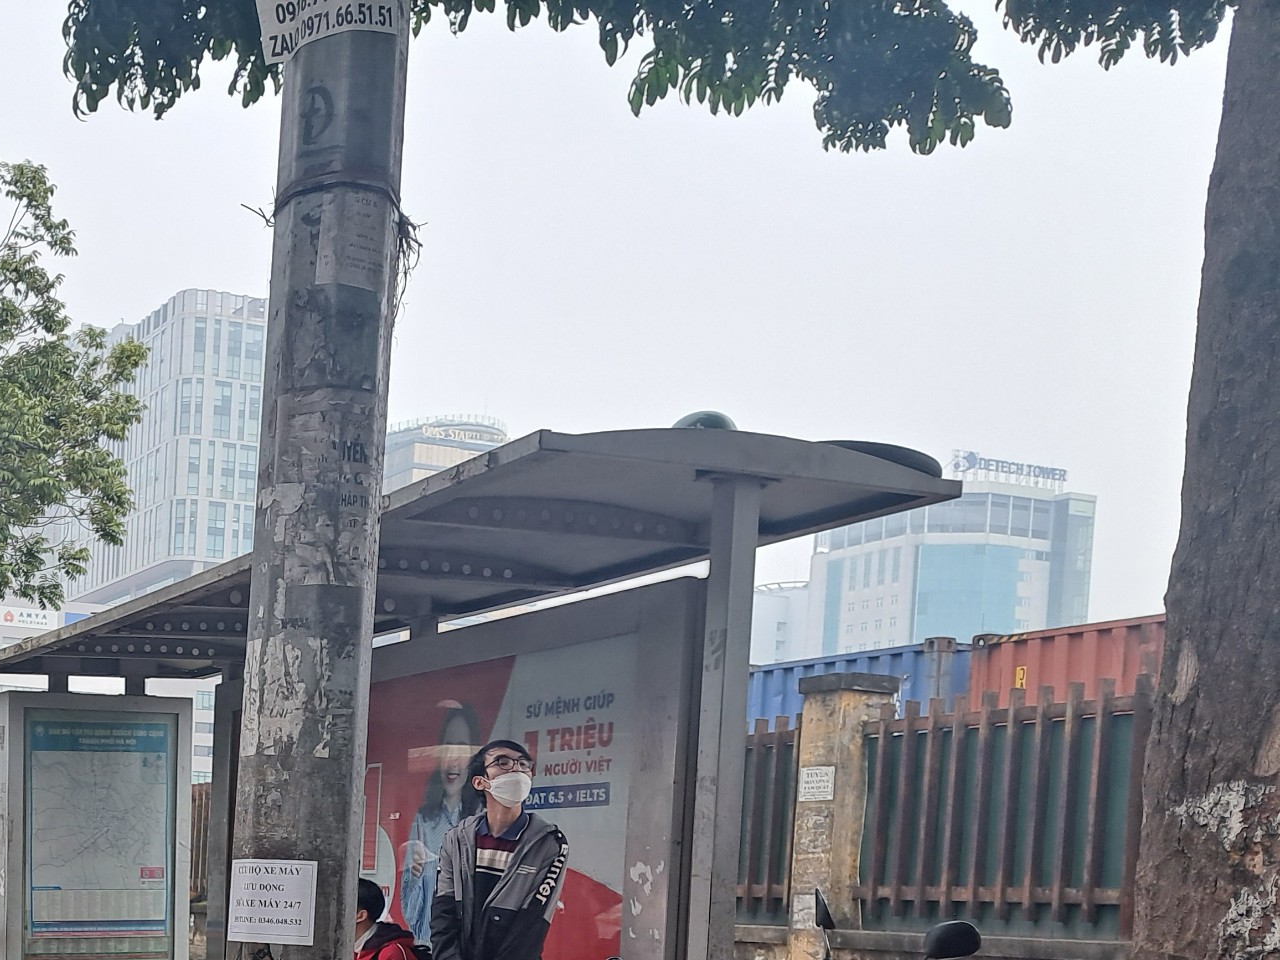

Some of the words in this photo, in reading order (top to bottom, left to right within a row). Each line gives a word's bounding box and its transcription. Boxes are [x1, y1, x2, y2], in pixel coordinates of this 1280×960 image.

[300, 5, 393, 40] 0971.66.51.51
[978, 457, 1024, 475] DETECH
[1025, 463, 1068, 482] TOWER
[525, 700, 543, 719] SỨ
[544, 696, 580, 719] MỆNH
[584, 689, 615, 711] GIÚP
[546, 717, 614, 756] TRIỆU
[544, 758, 582, 777] NGƯỜI
[586, 756, 613, 775] VIỆT
[548, 791, 565, 804] 6.5
[576, 788, 606, 802] IELTS
[263, 866, 277, 875] XE
[279, 865, 303, 876] MÁY
[259, 883, 285, 893] ĐỘNG
[258, 897, 282, 909] MÁY
[283, 900, 302, 910] 24/7
